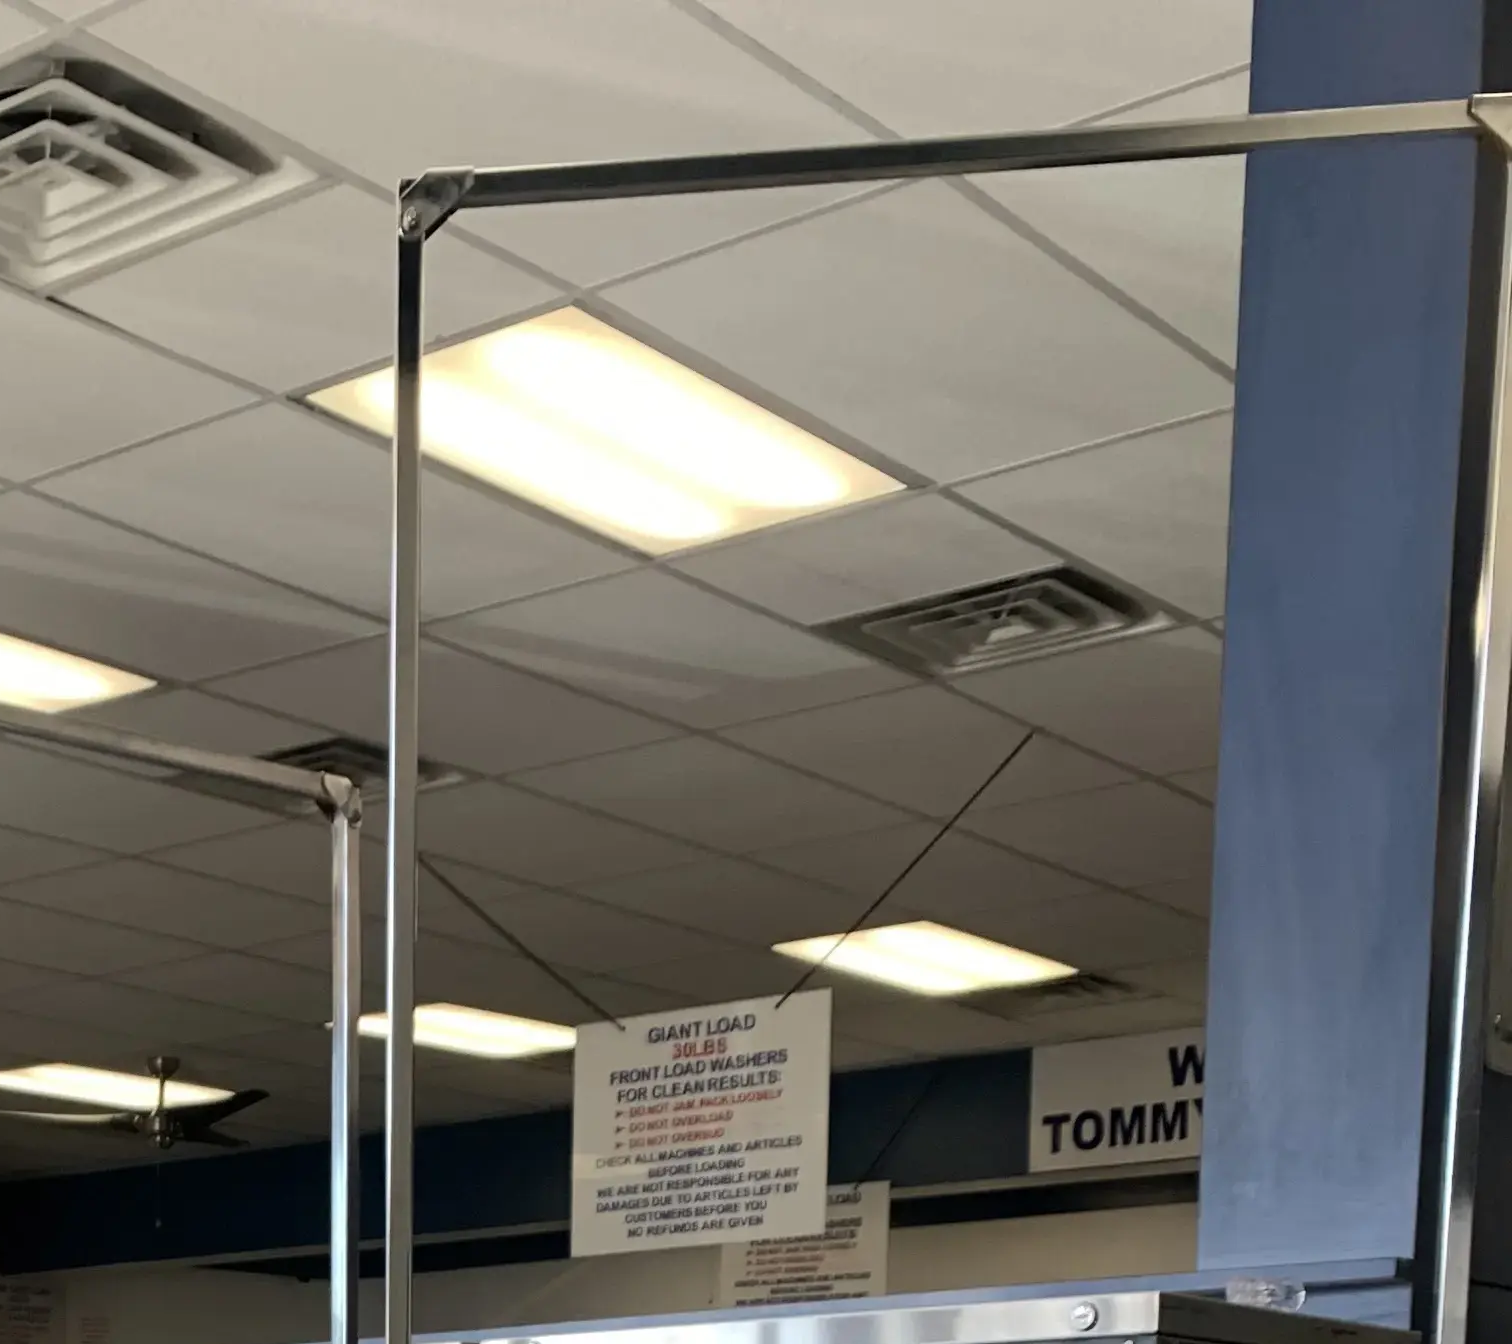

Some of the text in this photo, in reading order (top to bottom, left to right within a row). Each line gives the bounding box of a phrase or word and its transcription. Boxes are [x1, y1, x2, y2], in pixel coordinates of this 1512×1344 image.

[647, 1012, 756, 1044] GIANT LOAD
[609, 1048, 788, 1086] FRONT LOAD WASHERS
[617, 1086, 648, 1104] FOR
[651, 1078, 705, 1099] CLEAN
[634, 1151, 656, 1164] ALL
[744, 1134, 802, 1151] ARTICLES
